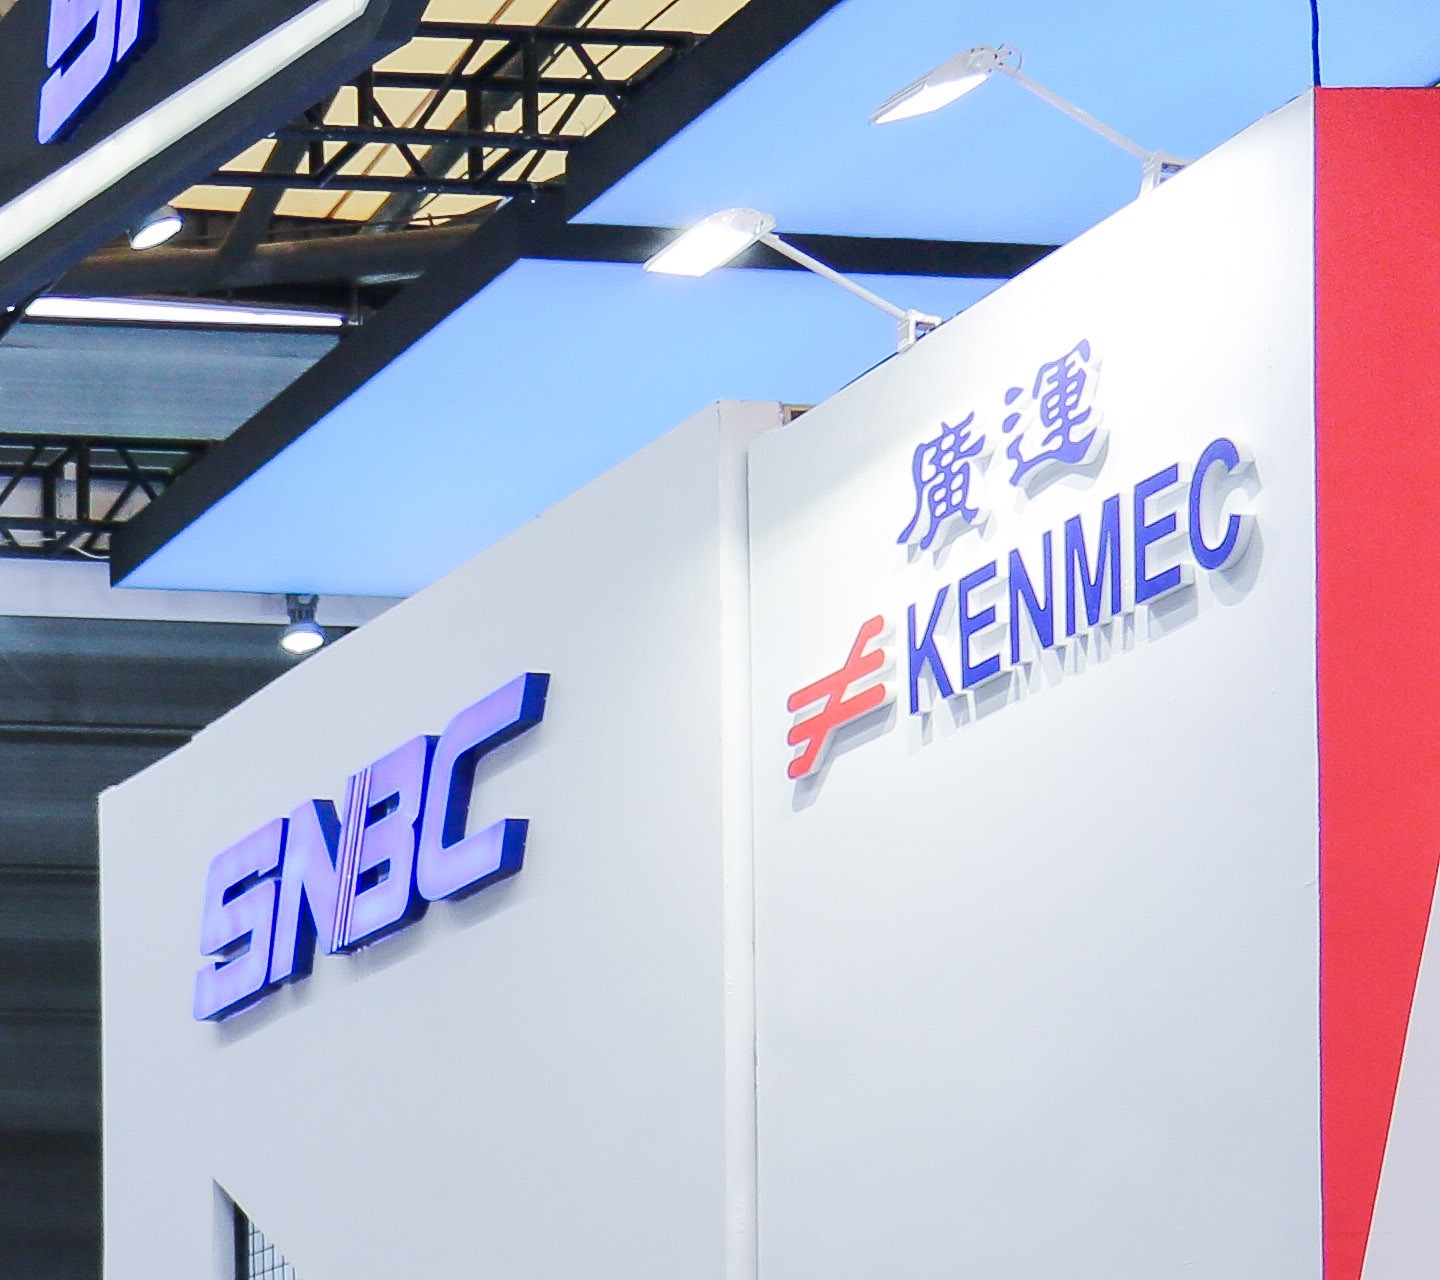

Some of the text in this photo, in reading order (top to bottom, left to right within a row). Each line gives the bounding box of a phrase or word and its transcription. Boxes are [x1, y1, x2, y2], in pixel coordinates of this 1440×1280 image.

[896, 338, 1102, 548] 廣運
[907, 437, 1243, 716] KENMEC
[194, 672, 550, 1022] SNBC
